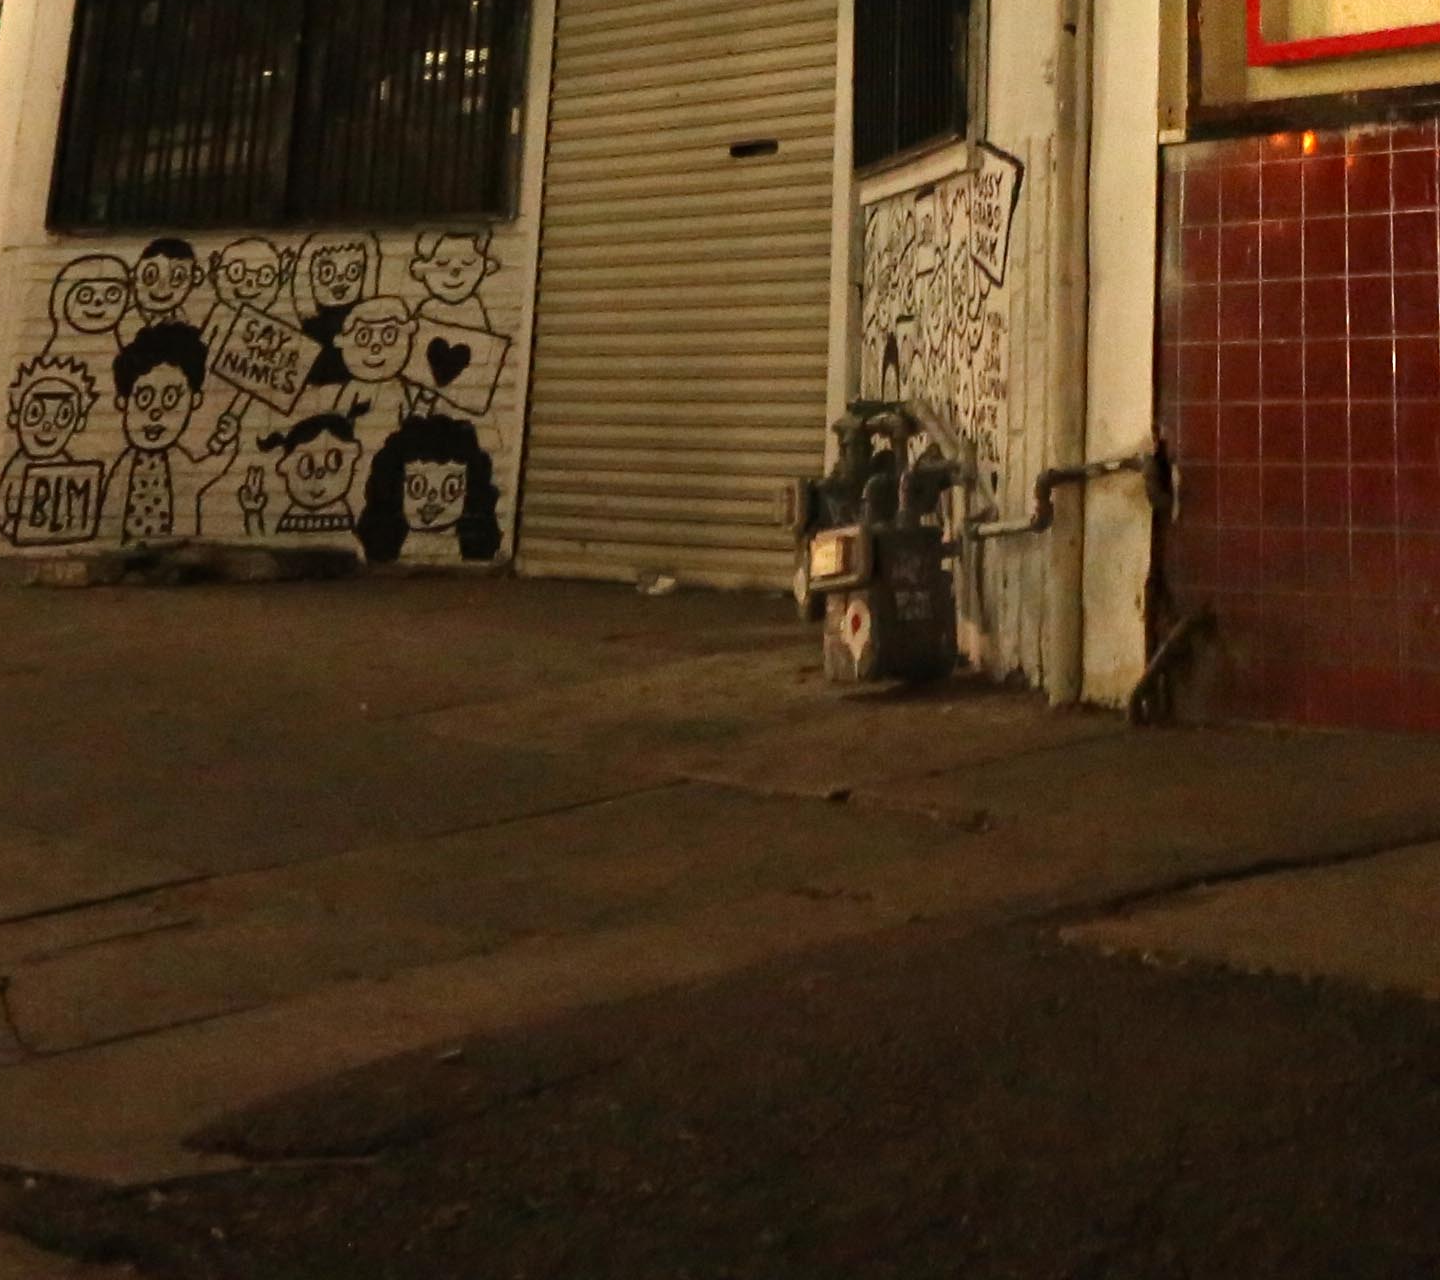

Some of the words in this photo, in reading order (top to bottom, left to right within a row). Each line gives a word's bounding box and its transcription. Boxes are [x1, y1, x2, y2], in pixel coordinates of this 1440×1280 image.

[242, 320, 293, 353] SAY
[221, 350, 299, 394] NAMES
[247, 344, 300, 369] THEIR
[28, 477, 92, 533] BLM
